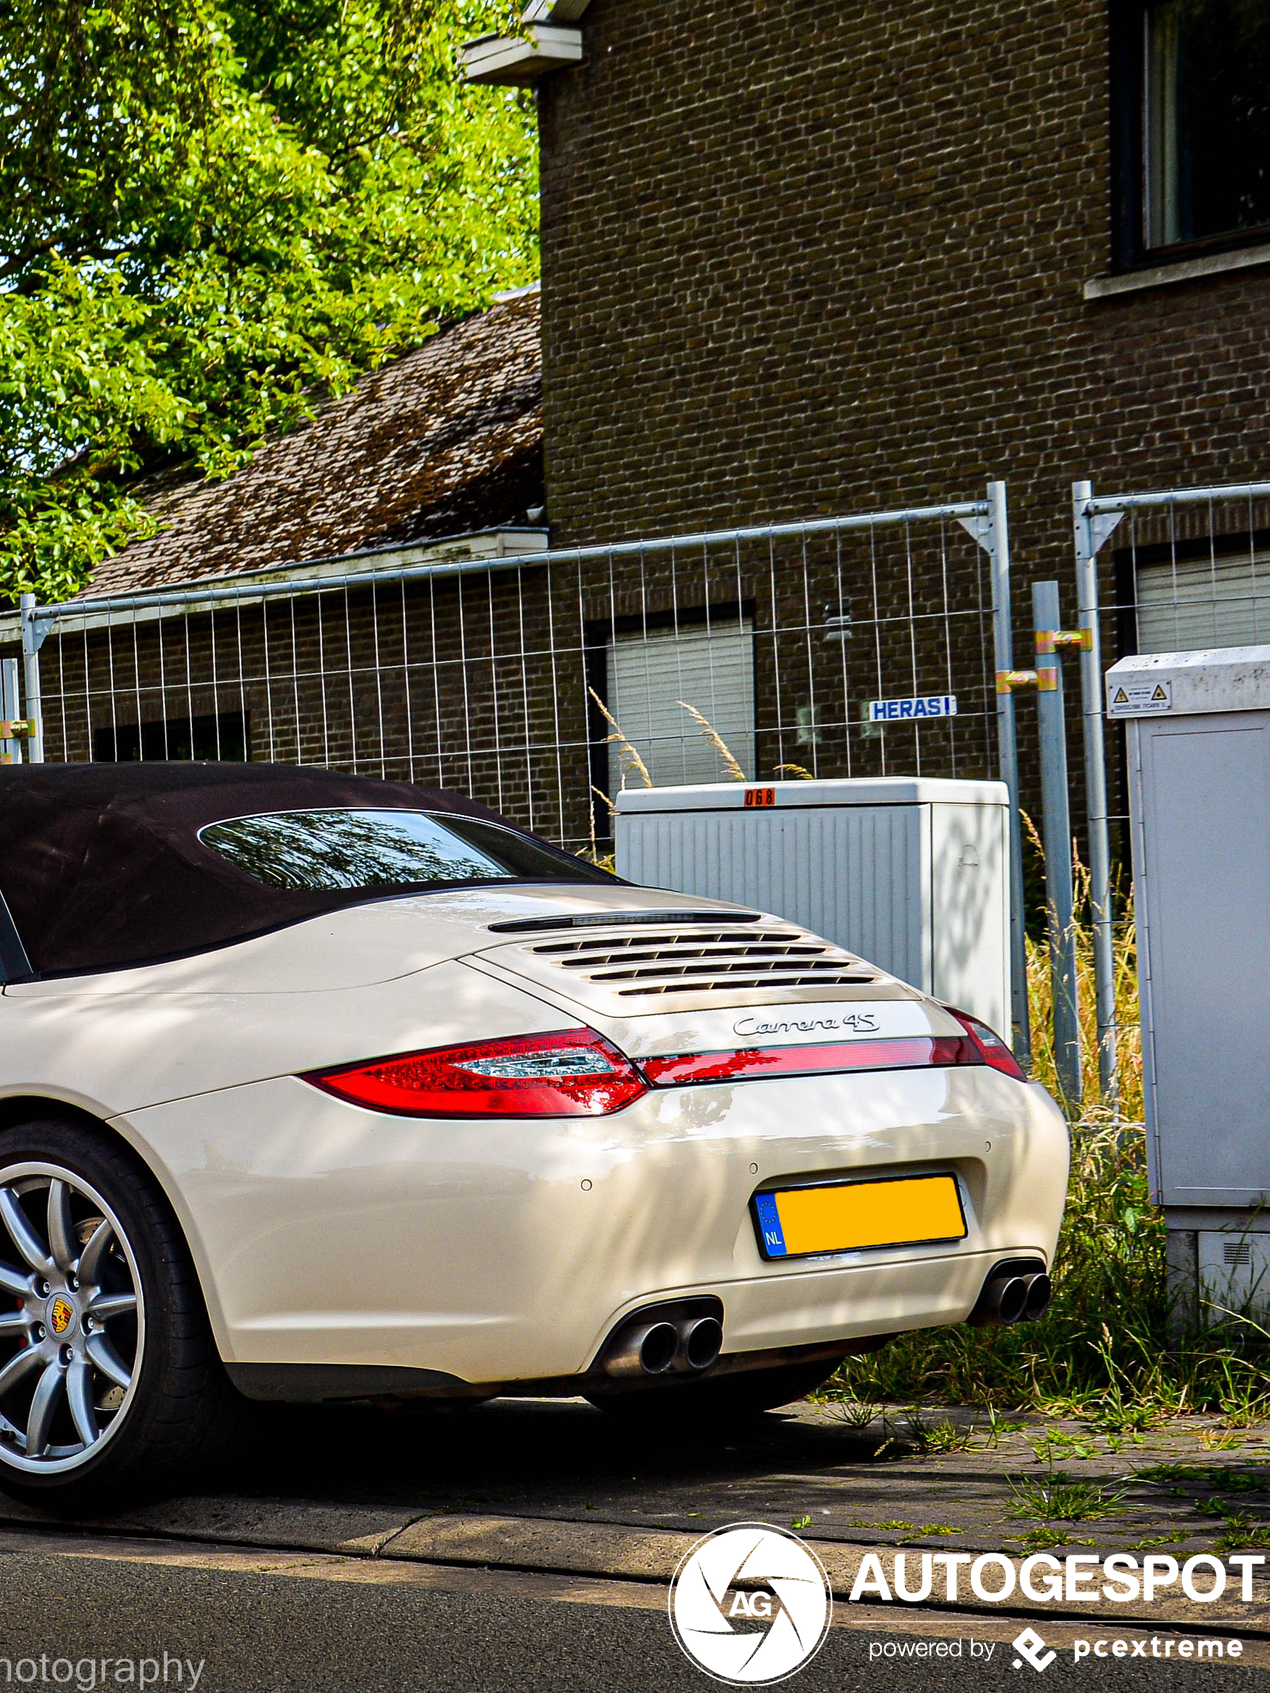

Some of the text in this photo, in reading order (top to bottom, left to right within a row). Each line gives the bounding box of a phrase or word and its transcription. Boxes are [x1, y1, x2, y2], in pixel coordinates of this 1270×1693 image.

[745, 788, 773, 806] 068
[843, 1013, 880, 1032] 4S
[765, 1231, 783, 1246] NL
